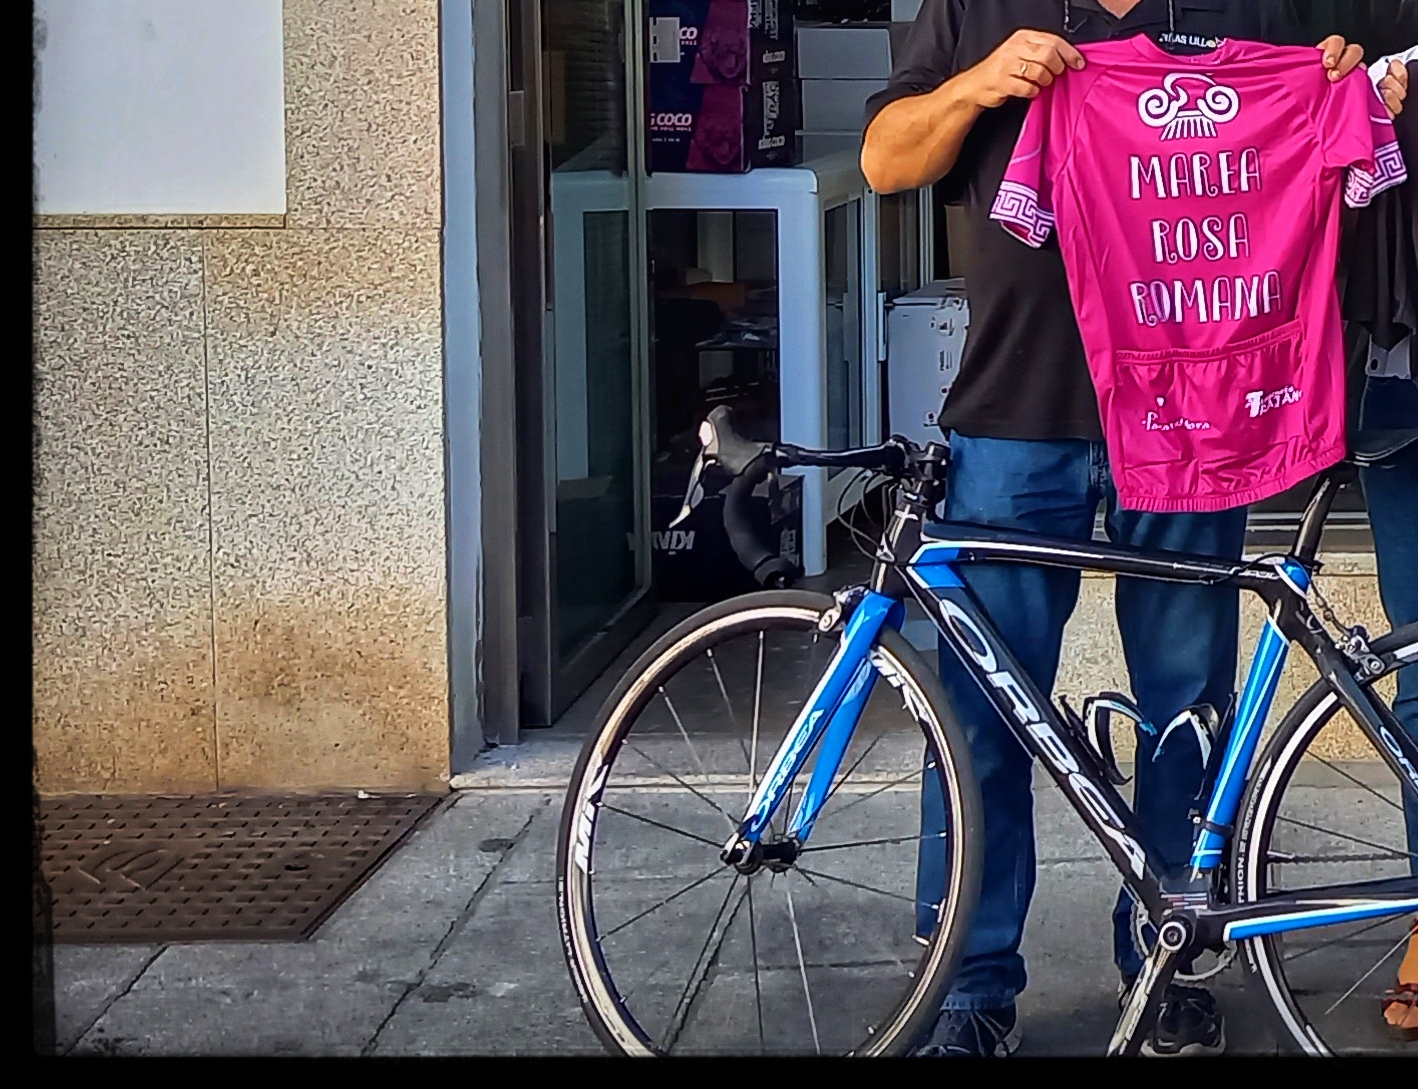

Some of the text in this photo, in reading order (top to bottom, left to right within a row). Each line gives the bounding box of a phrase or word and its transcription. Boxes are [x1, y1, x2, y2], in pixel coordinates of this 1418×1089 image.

[1130, 147, 1263, 200] MAREA
[1151, 212, 1251, 265] ROSA
[1129, 270, 1284, 327] ROMANA
[938, 598, 1147, 881] ORBEA
[750, 707, 826, 834] ORBEA
